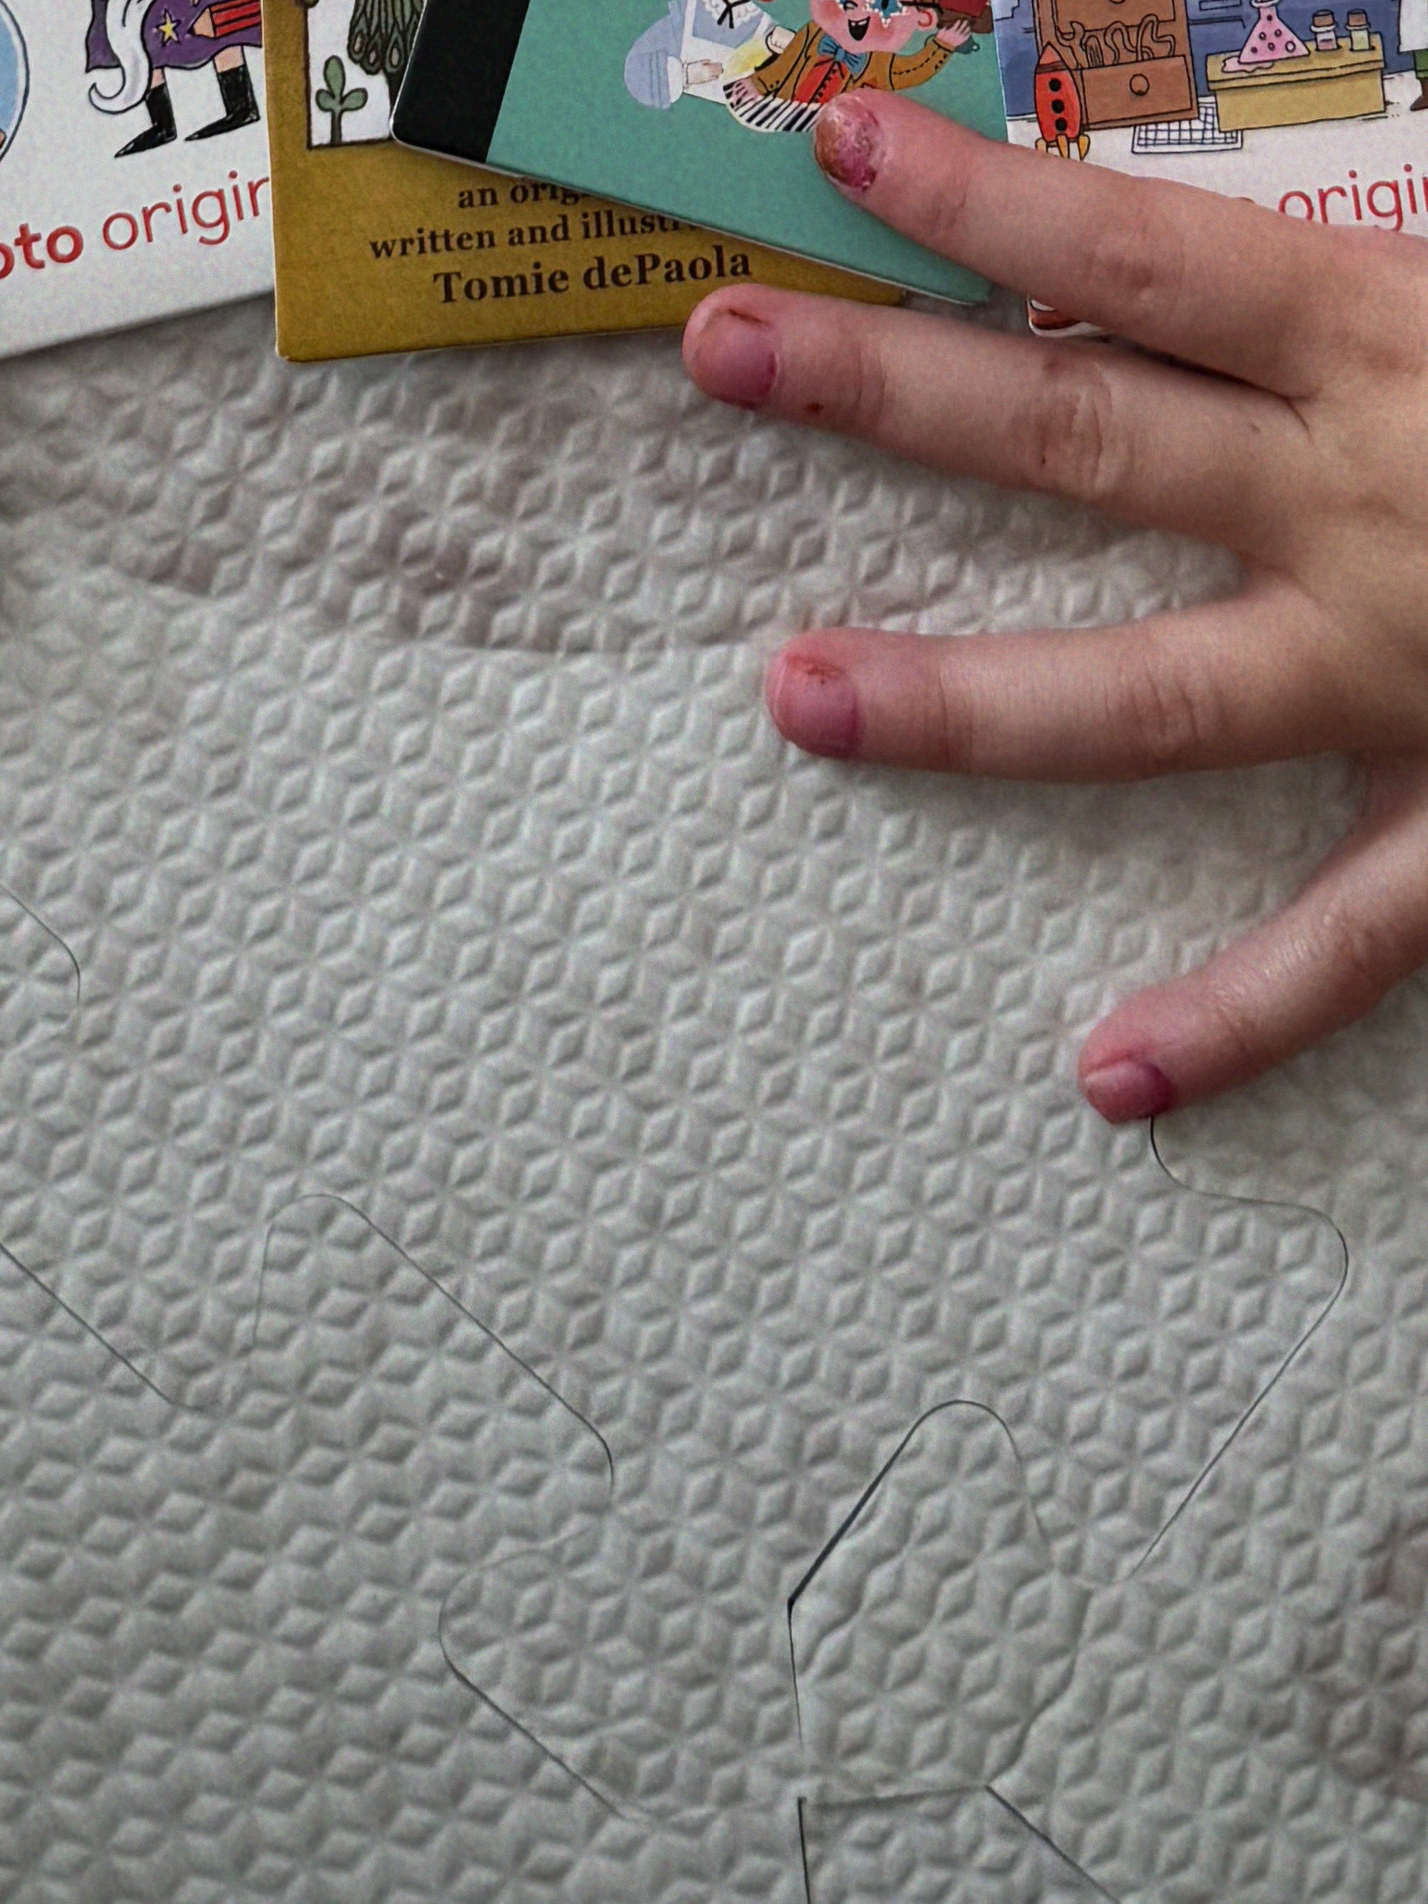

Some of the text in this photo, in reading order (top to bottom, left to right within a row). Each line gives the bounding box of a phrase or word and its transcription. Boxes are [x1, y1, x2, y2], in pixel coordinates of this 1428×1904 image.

[458, 186, 499, 209] an
[370, 228, 496, 259] written
[508, 216, 571, 247] and
[433, 245, 752, 303] Tomie dePaola
